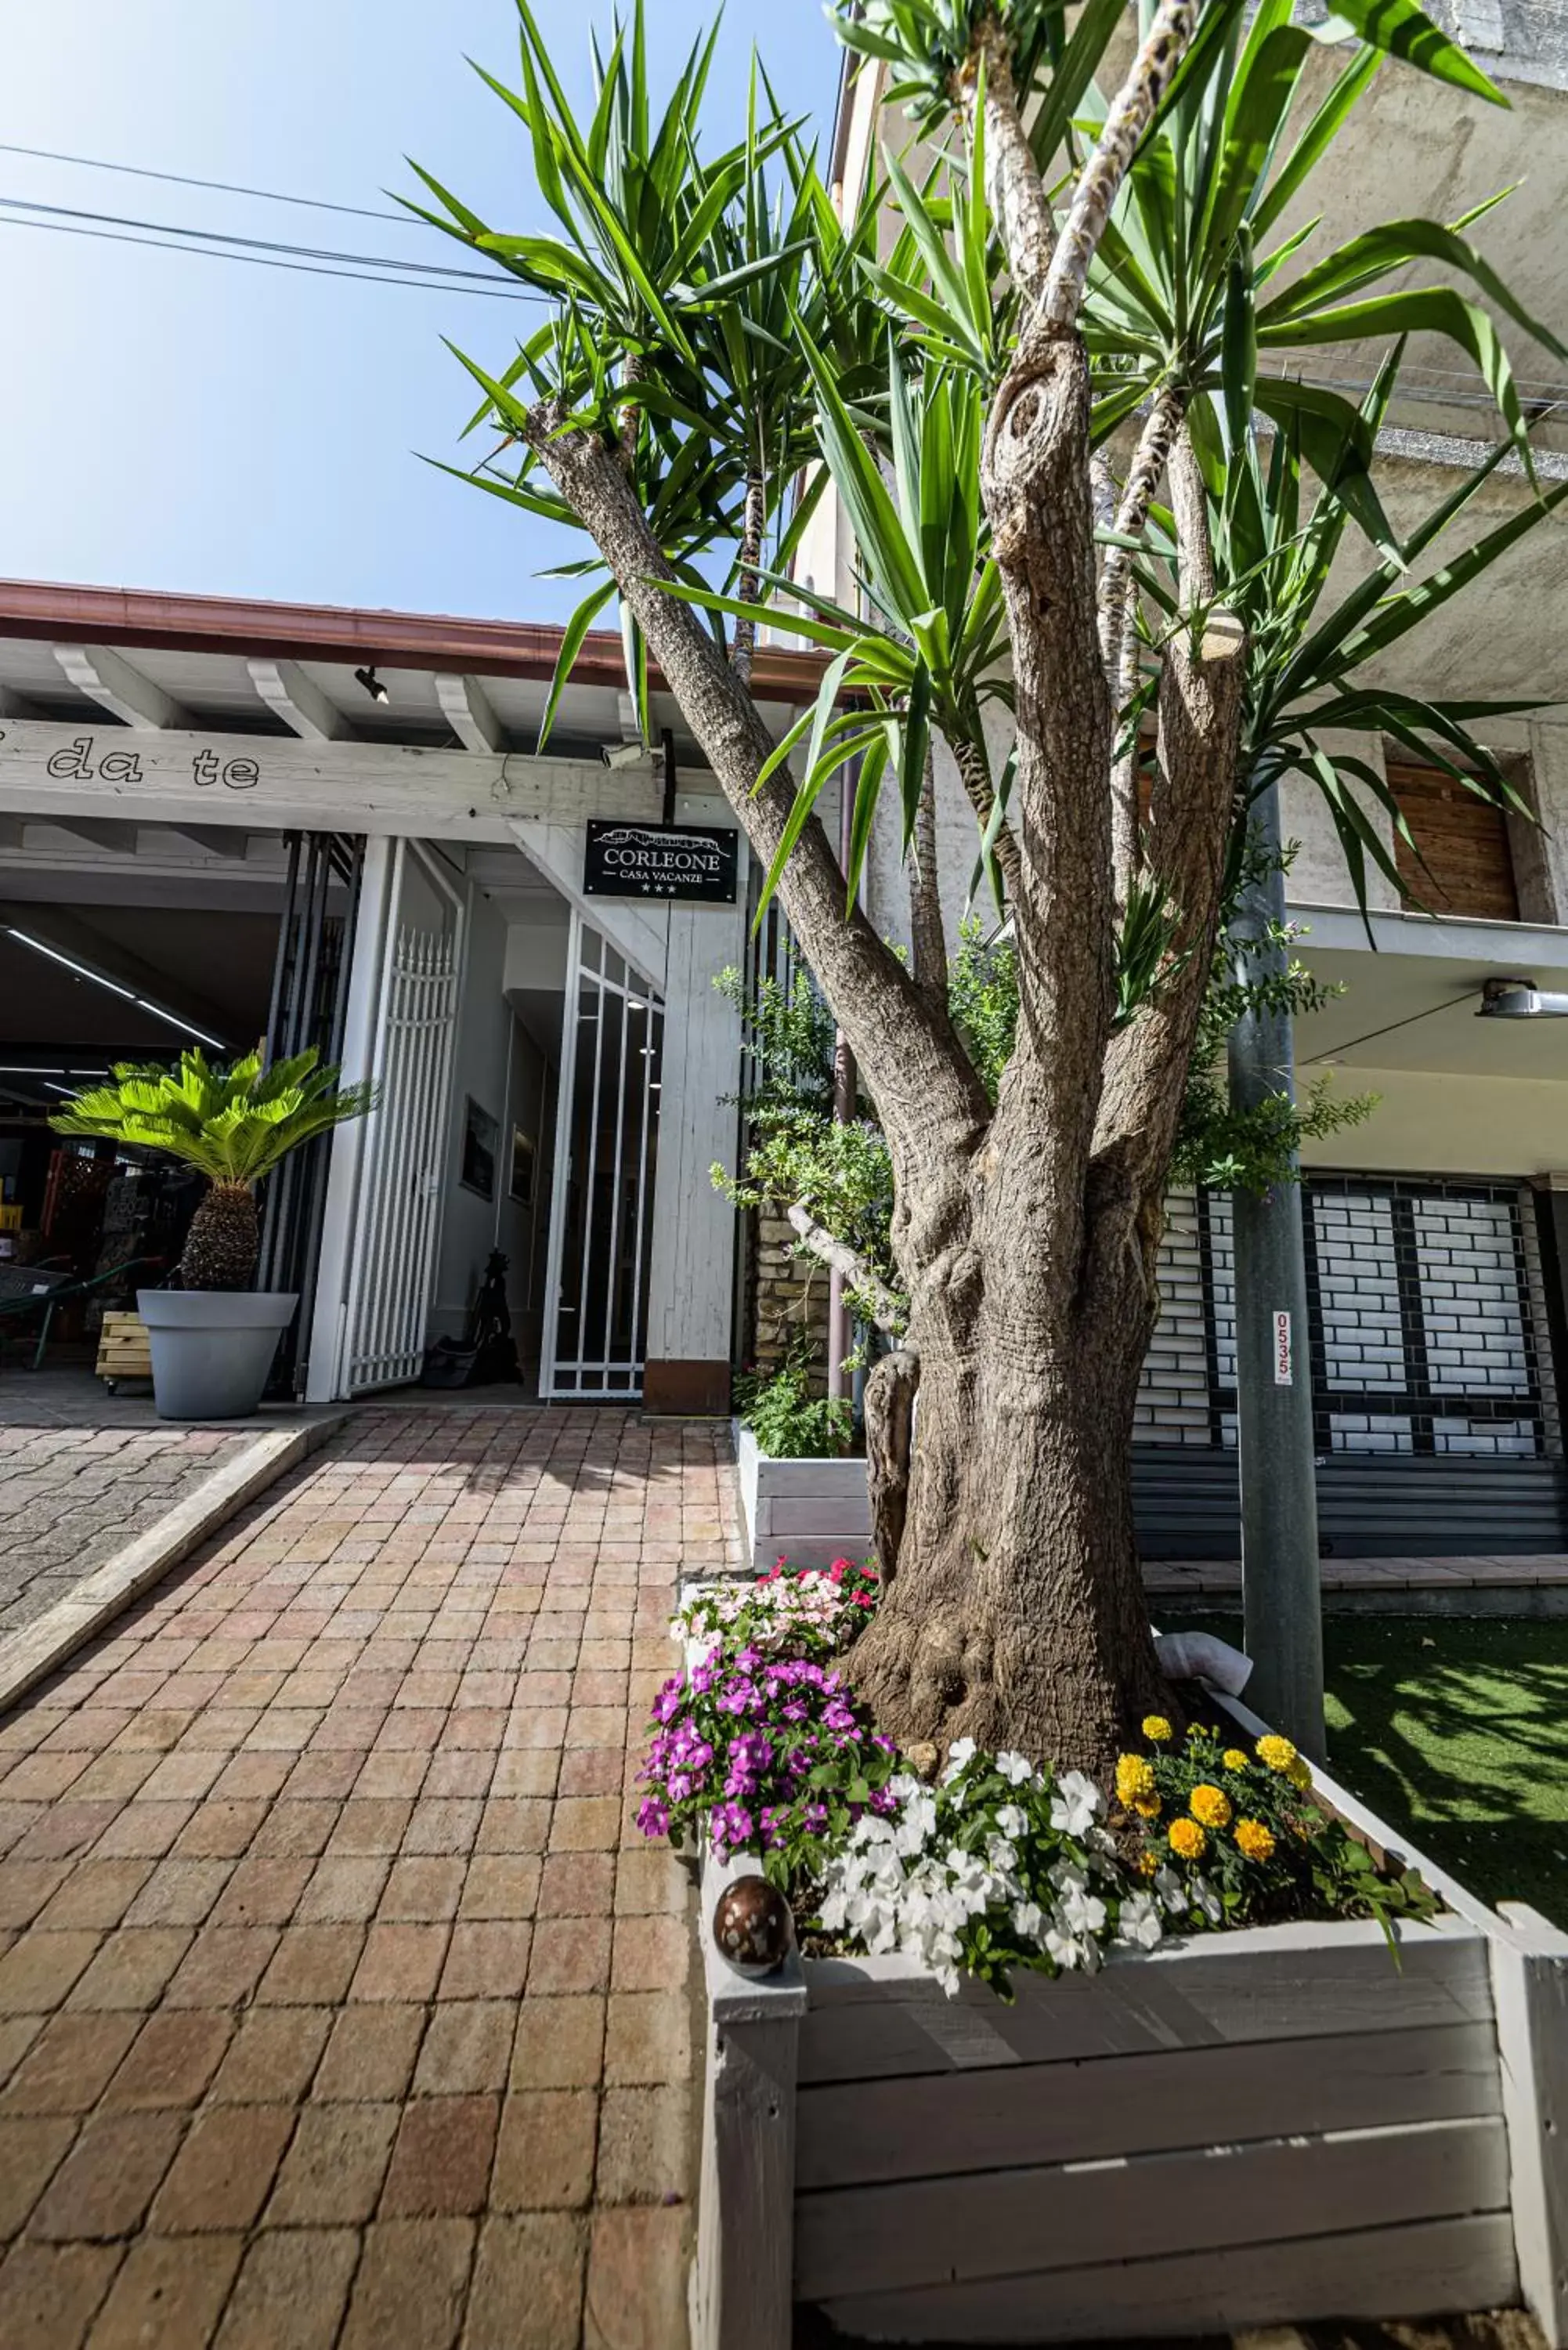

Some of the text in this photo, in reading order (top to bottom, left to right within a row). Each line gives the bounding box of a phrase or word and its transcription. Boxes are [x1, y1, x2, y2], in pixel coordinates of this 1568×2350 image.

[47, 737, 259, 789] da te
[604, 848, 720, 870] CORLEONE
[620, 870, 702, 884] CASA VACANZE
[1277, 1314, 1288, 1374] 0535
